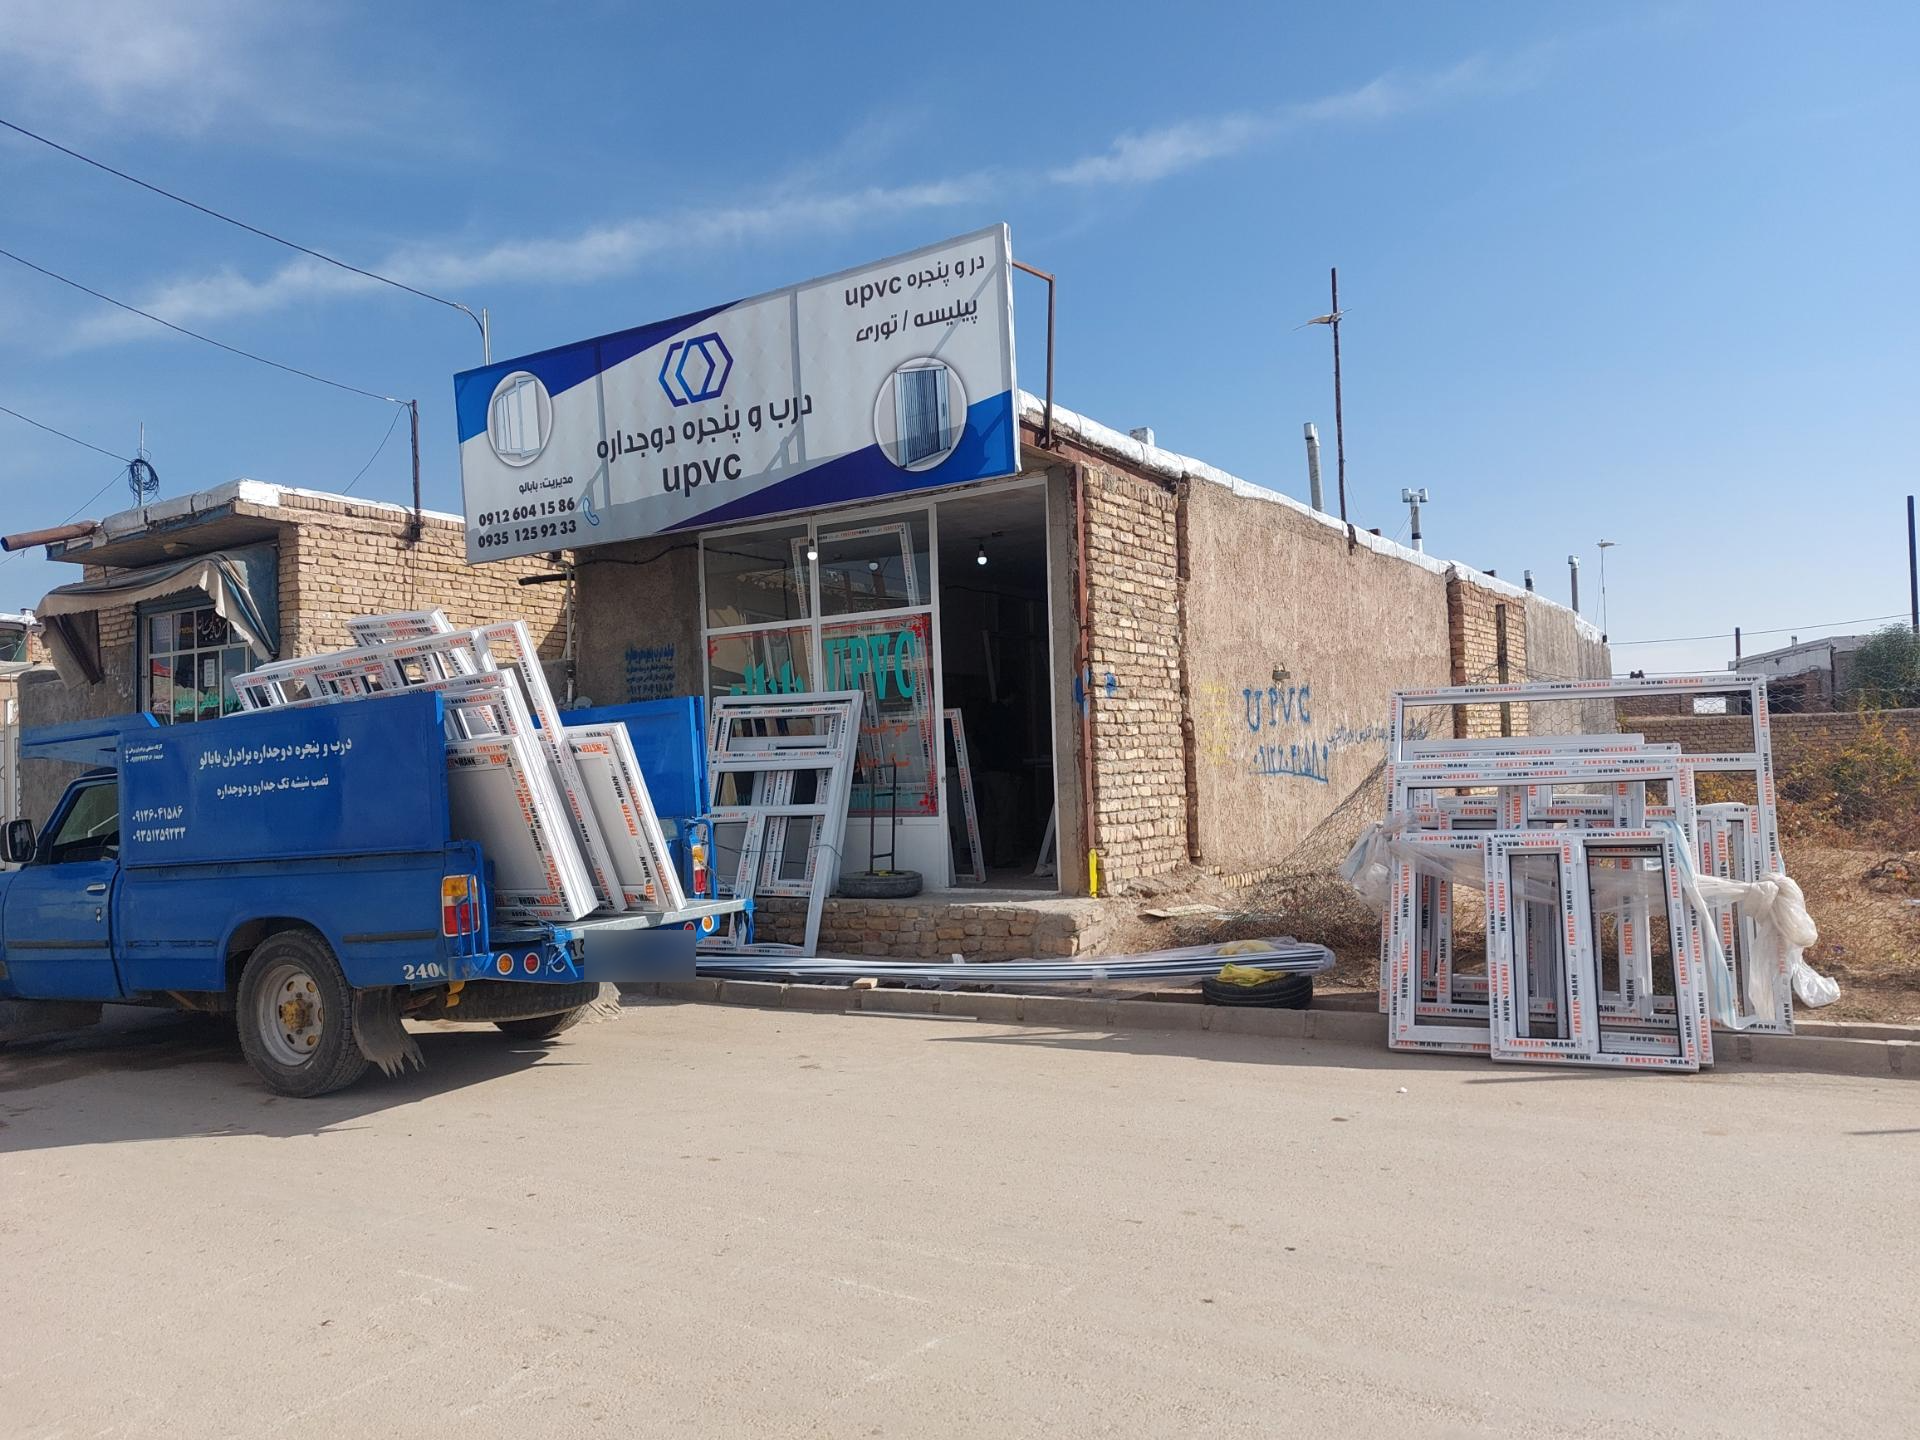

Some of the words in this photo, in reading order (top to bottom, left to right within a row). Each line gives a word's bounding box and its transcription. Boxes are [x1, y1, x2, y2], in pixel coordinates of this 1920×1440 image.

[907, 261, 949, 289] پنجره
[954, 260, 965, 279] و
[969, 255, 985, 276] در
[845, 276, 902, 308] upvc
[913, 299, 978, 324] پیلیسه
[856, 314, 898, 342] توری
[747, 405, 762, 432] و
[769, 394, 813, 429] درب
[682, 404, 741, 444] پنجره
[596, 424, 676, 463] دوجداره
[662, 453, 742, 498] upvc
[518, 481, 539, 495] بابالو
[478, 509, 510, 527] 0912
[512, 503, 537, 521] 604
[540, 500, 556, 516] 15
[558, 497, 576, 513] 86
[478, 531, 509, 548] 0935
[514, 526, 538, 542] 125
[540, 523, 557, 538] 92
[560, 519, 577, 535] 33
[824, 631, 916, 699] UPVC
[1242, 685, 1311, 732] UPVC
[222, 746, 252, 767] برادران
[294, 740, 320, 759] پنجره
[323, 743, 329, 757] و
[330, 737, 353, 755] درب
[199, 750, 221, 770] بابالو
[252, 780, 276, 796] جداره
[276, 777, 290, 790] تک
[291, 776, 310, 791] شیشه
[310, 773, 329, 789] نصب
[611, 775, 624, 799] MANN
[640, 856, 652, 879] MANN
[1509, 1040, 1545, 1048] FENSTER
[1625, 1056, 1664, 1064] FENSTER
